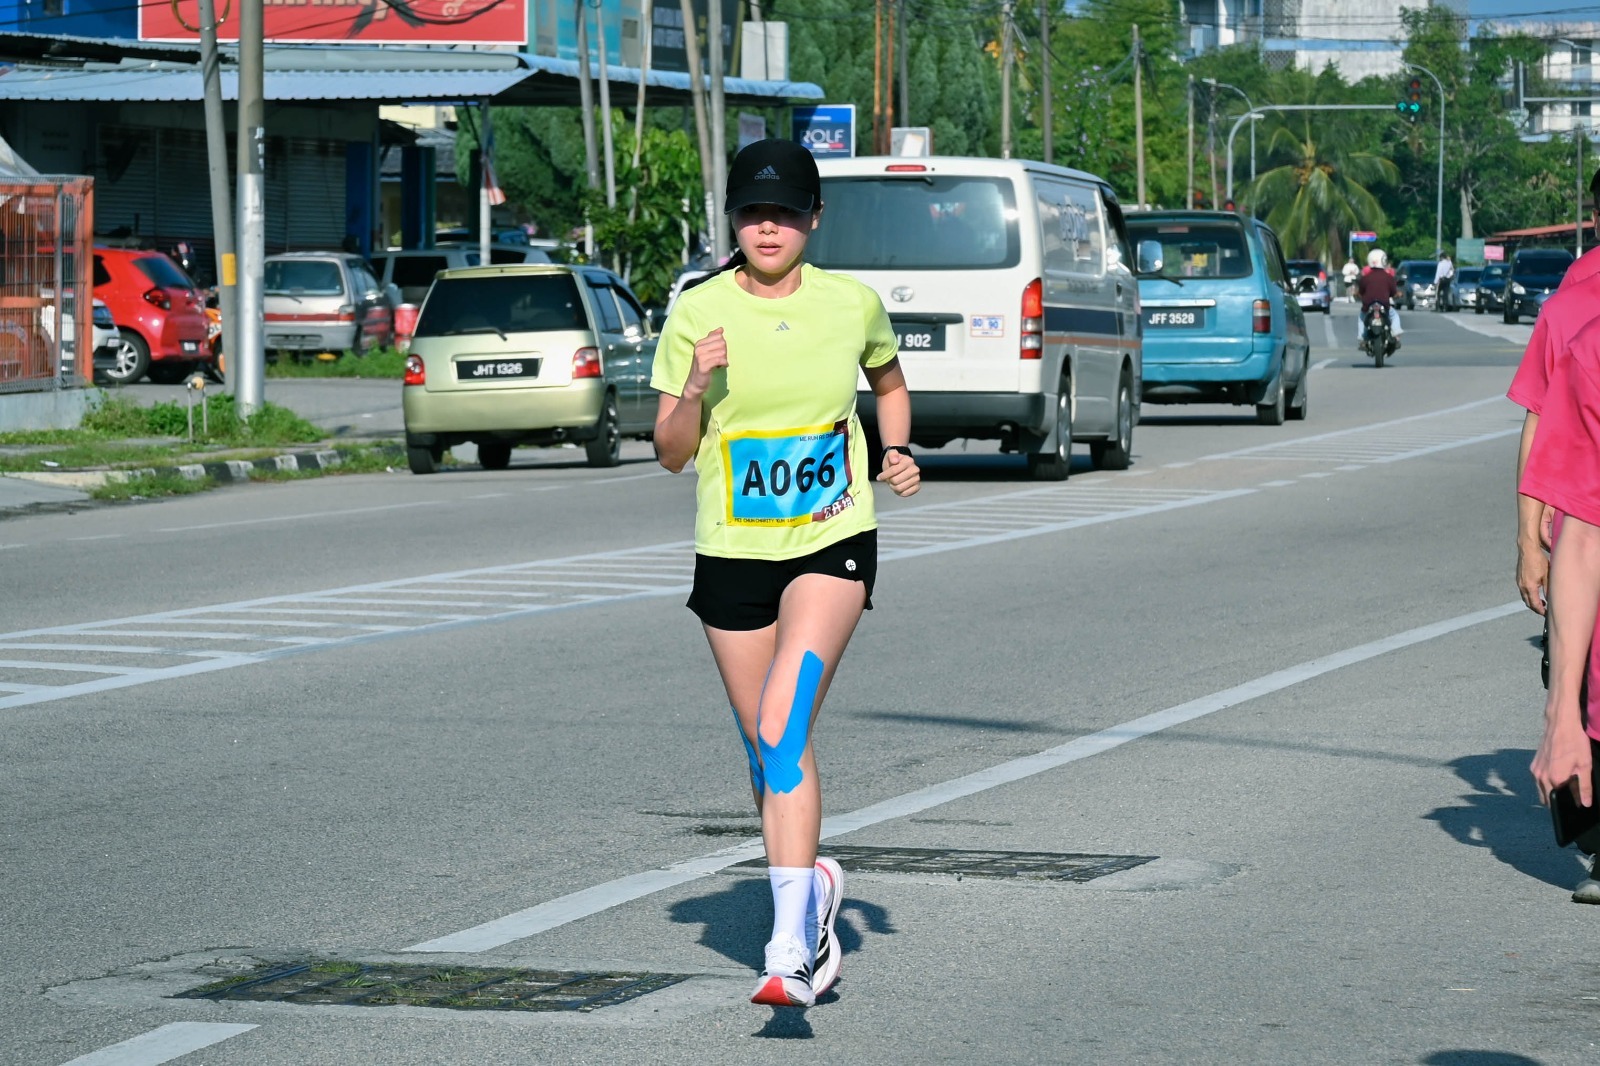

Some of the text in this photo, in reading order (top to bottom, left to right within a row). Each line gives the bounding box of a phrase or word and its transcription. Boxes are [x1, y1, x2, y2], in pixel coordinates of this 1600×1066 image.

[1149, 312, 1195, 324] JFF 3528
[905, 333, 931, 347] 902
[473, 362, 523, 376] JHT 1326
[742, 452, 835, 496] A066
